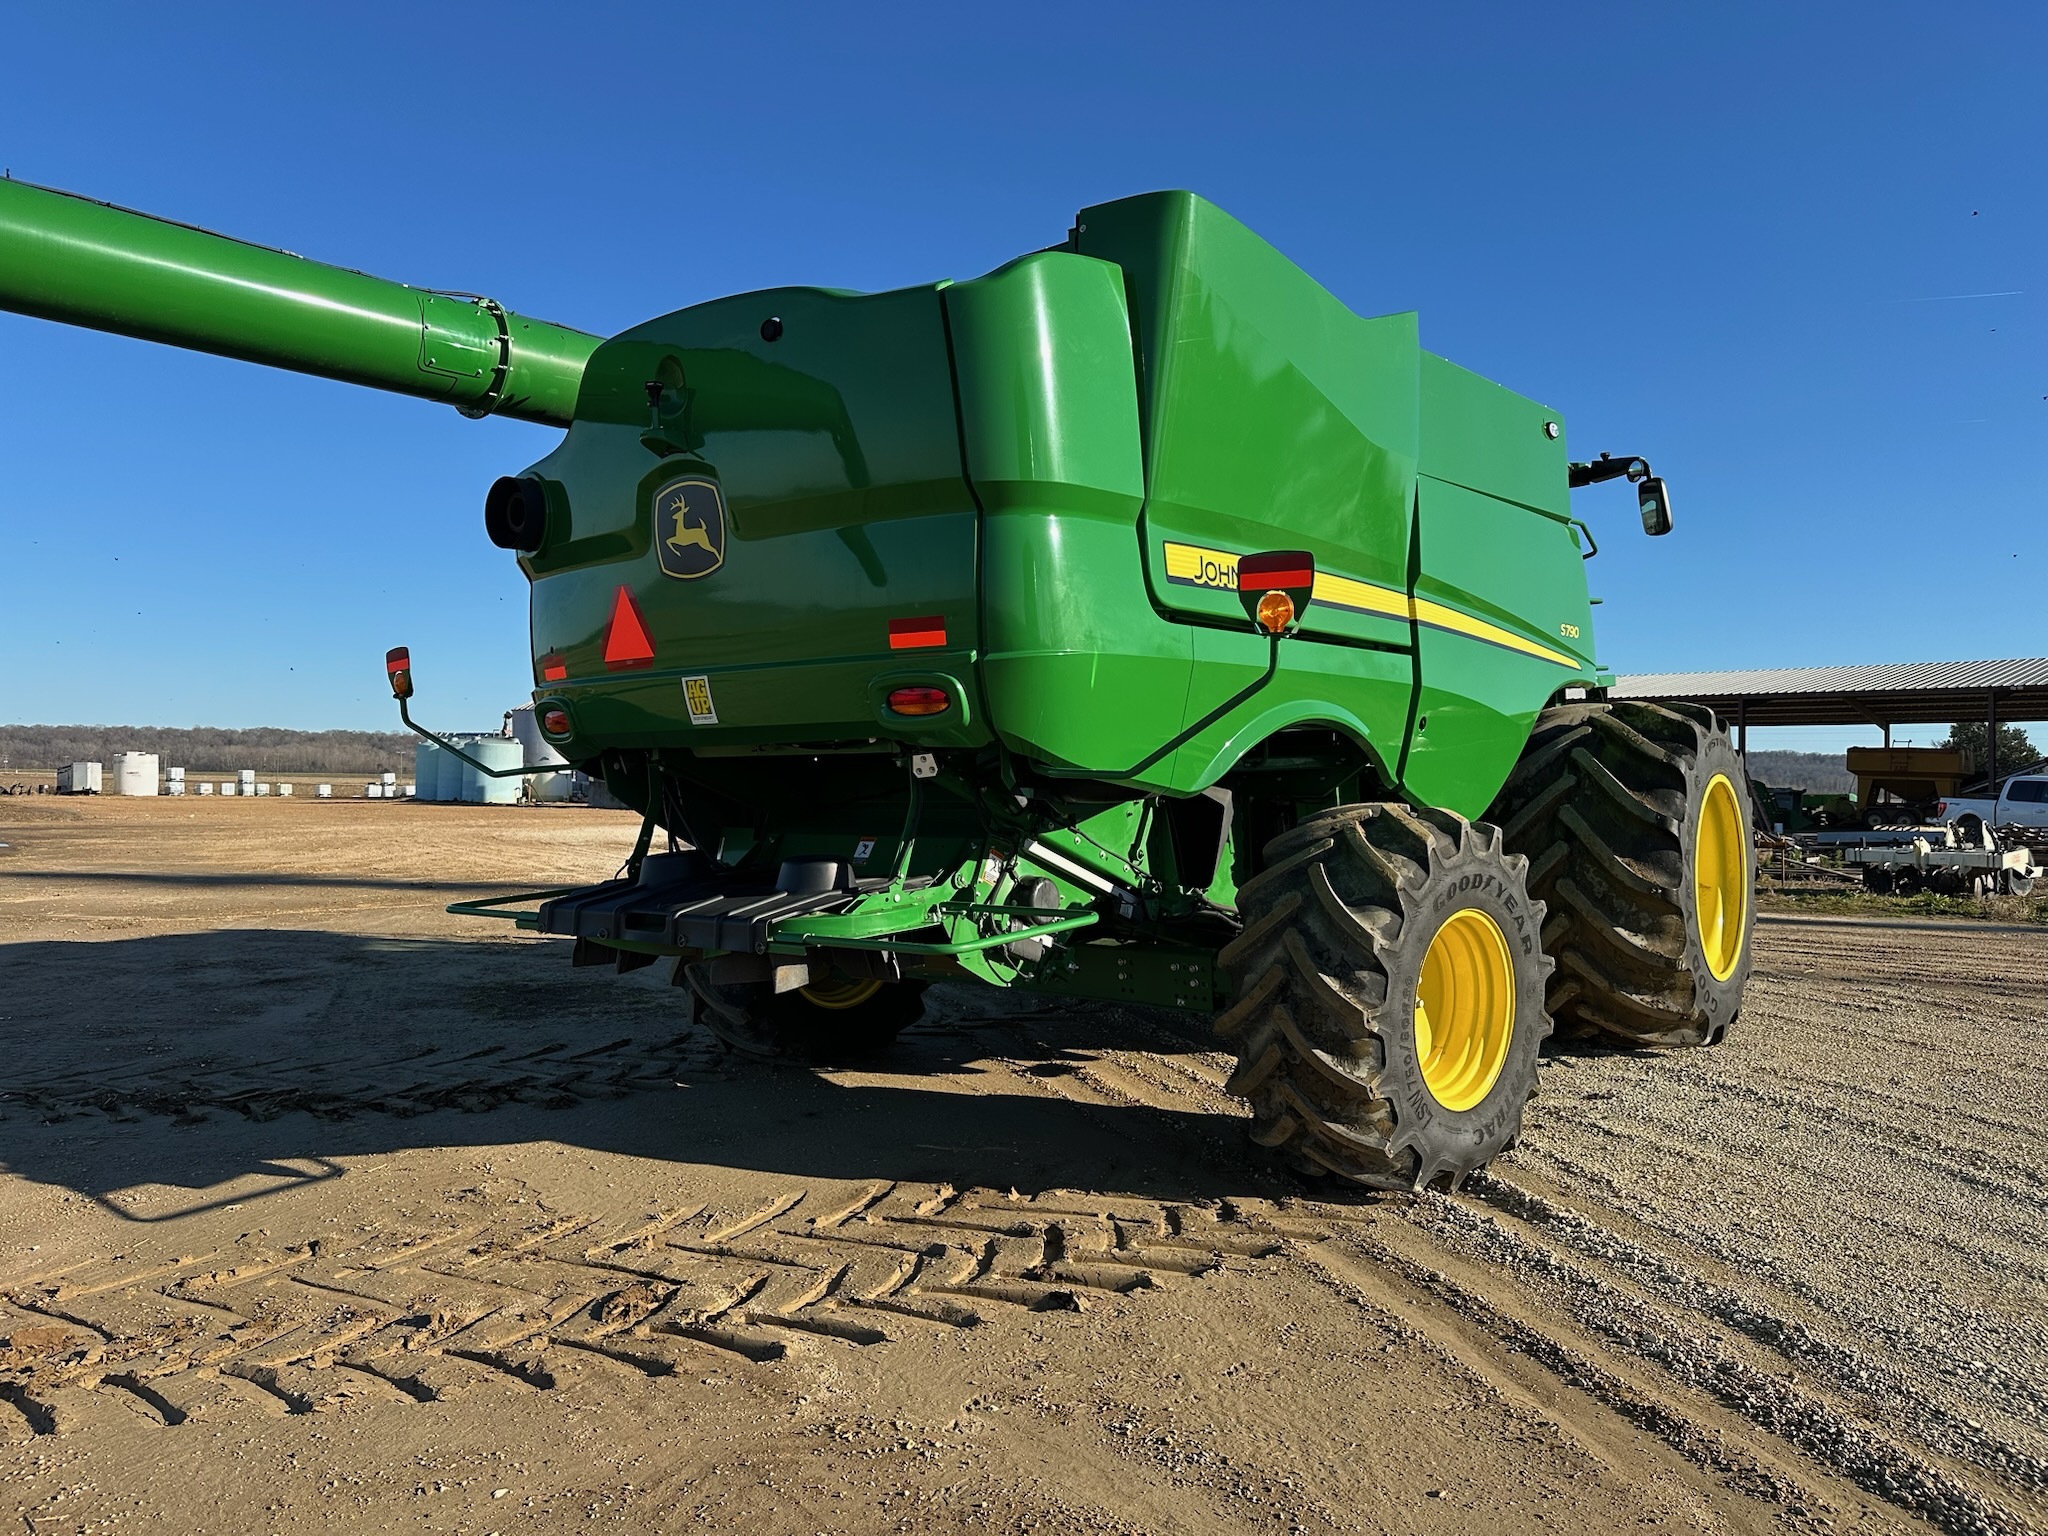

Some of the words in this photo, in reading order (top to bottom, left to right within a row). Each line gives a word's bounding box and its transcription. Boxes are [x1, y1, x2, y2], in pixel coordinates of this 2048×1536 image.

[1560, 623, 1580, 639] S790
[687, 679, 707, 697] AG
[690, 697, 710, 714] UP
[1433, 873, 1532, 956] GOODYEAR
